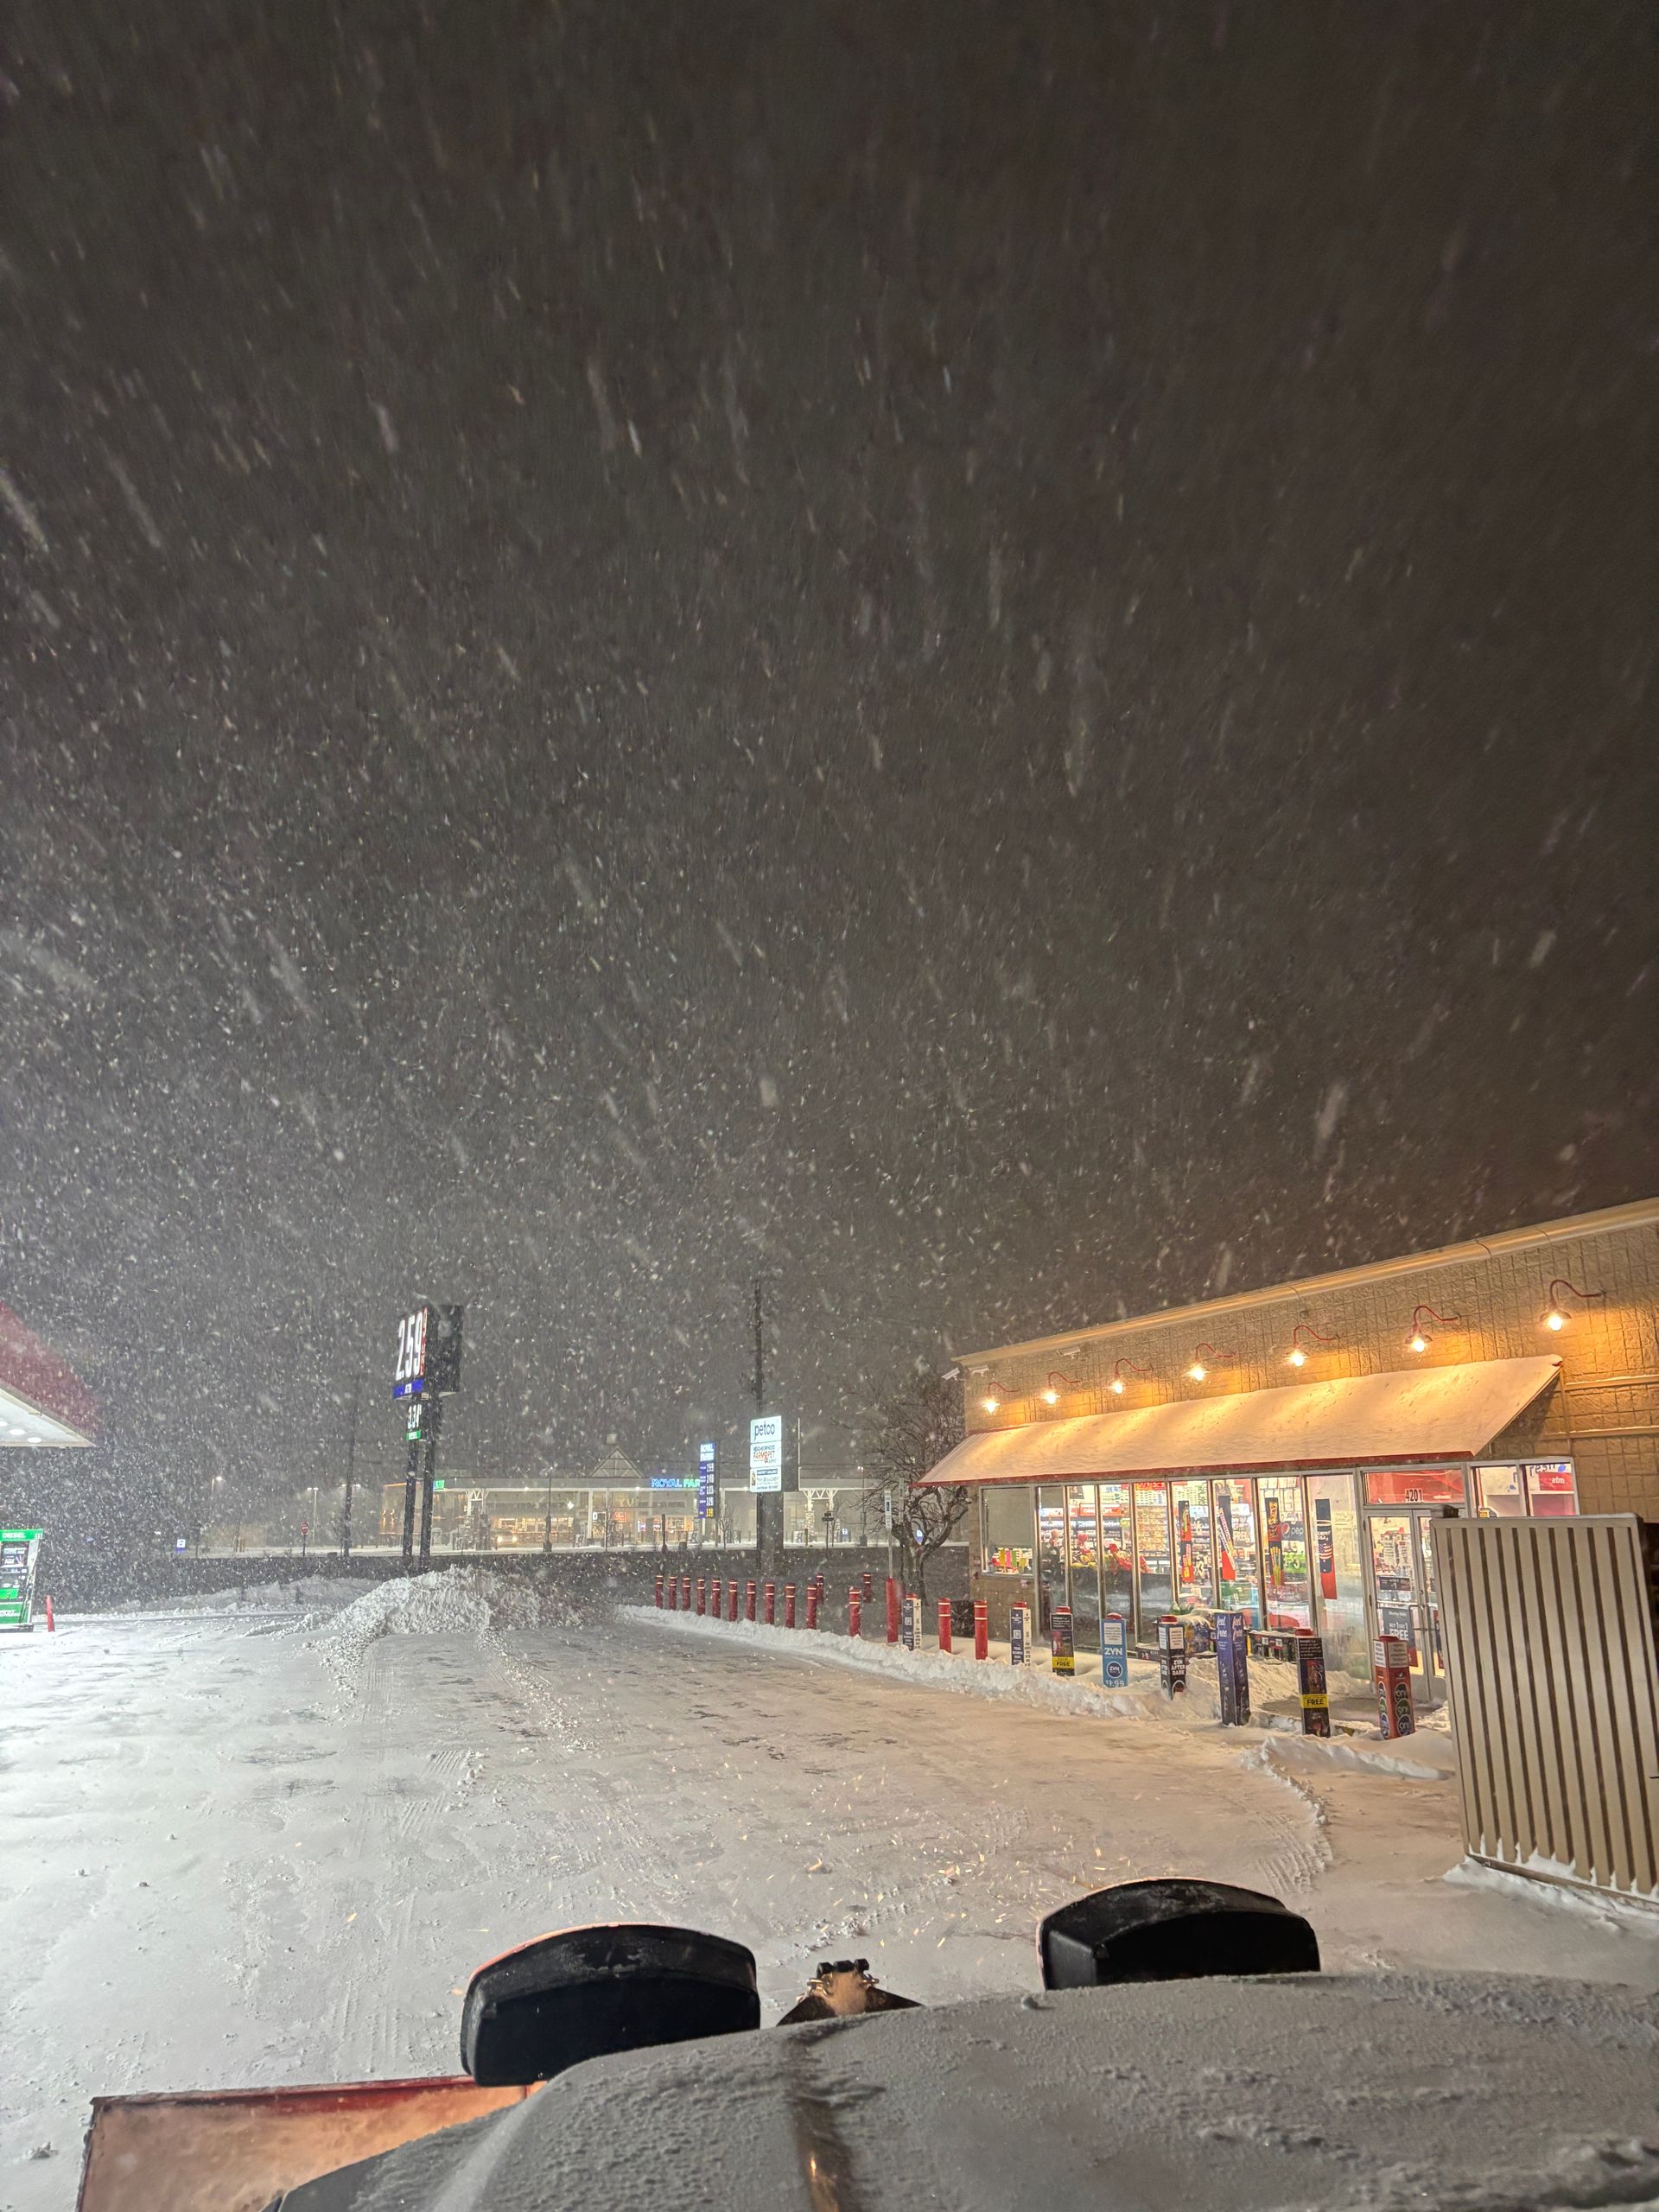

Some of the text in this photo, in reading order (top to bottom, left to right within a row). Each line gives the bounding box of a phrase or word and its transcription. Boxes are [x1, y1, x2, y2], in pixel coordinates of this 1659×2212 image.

[754, 1421, 775, 1441] petco
[651, 1478, 683, 1488] ROYAL
[1405, 1489, 1423, 1502] 4201
[1217, 1616, 1226, 1629] feel
[1217, 1628, 1227, 1640] free
